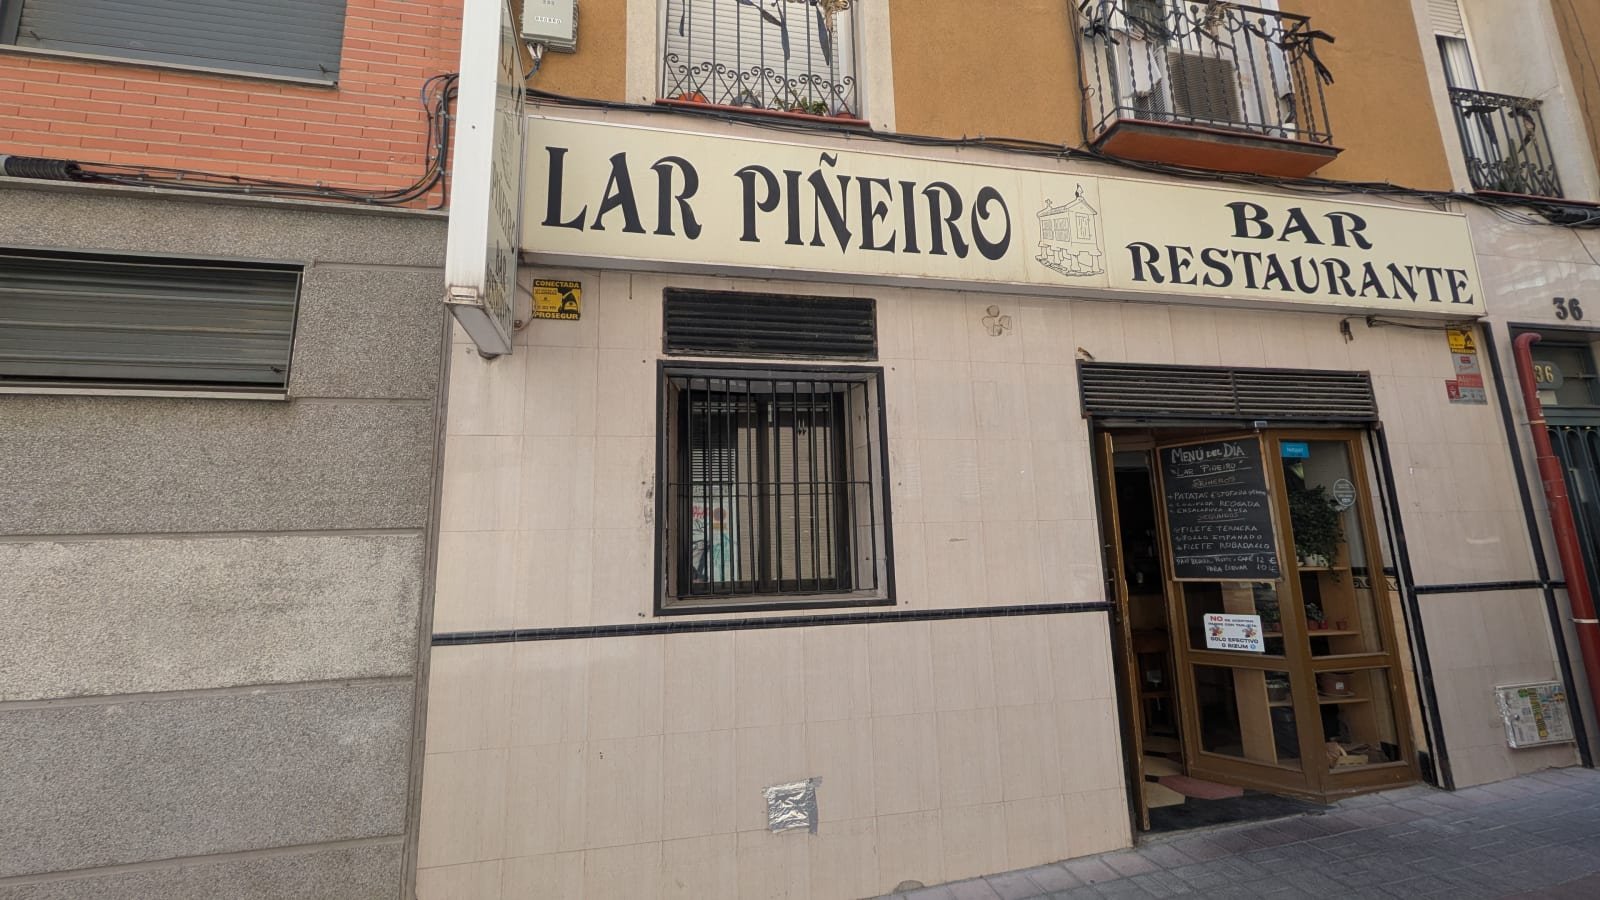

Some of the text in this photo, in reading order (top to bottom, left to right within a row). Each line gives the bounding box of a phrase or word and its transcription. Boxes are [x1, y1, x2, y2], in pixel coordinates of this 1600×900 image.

[541, 146, 1011, 260] LAR PIÑEIRO
[1224, 201, 1373, 250] BAR
[535, 280, 580, 288] CONECTADA
[1125, 241, 1474, 306] RESTAURANTE
[533, 311, 578, 320] PROSEGUR
[1552, 297, 1583, 321] 36
[1534, 365, 1553, 383] 36
[1171, 446, 1204, 464] MENÚ
[1223, 442, 1245, 457] DÍA
